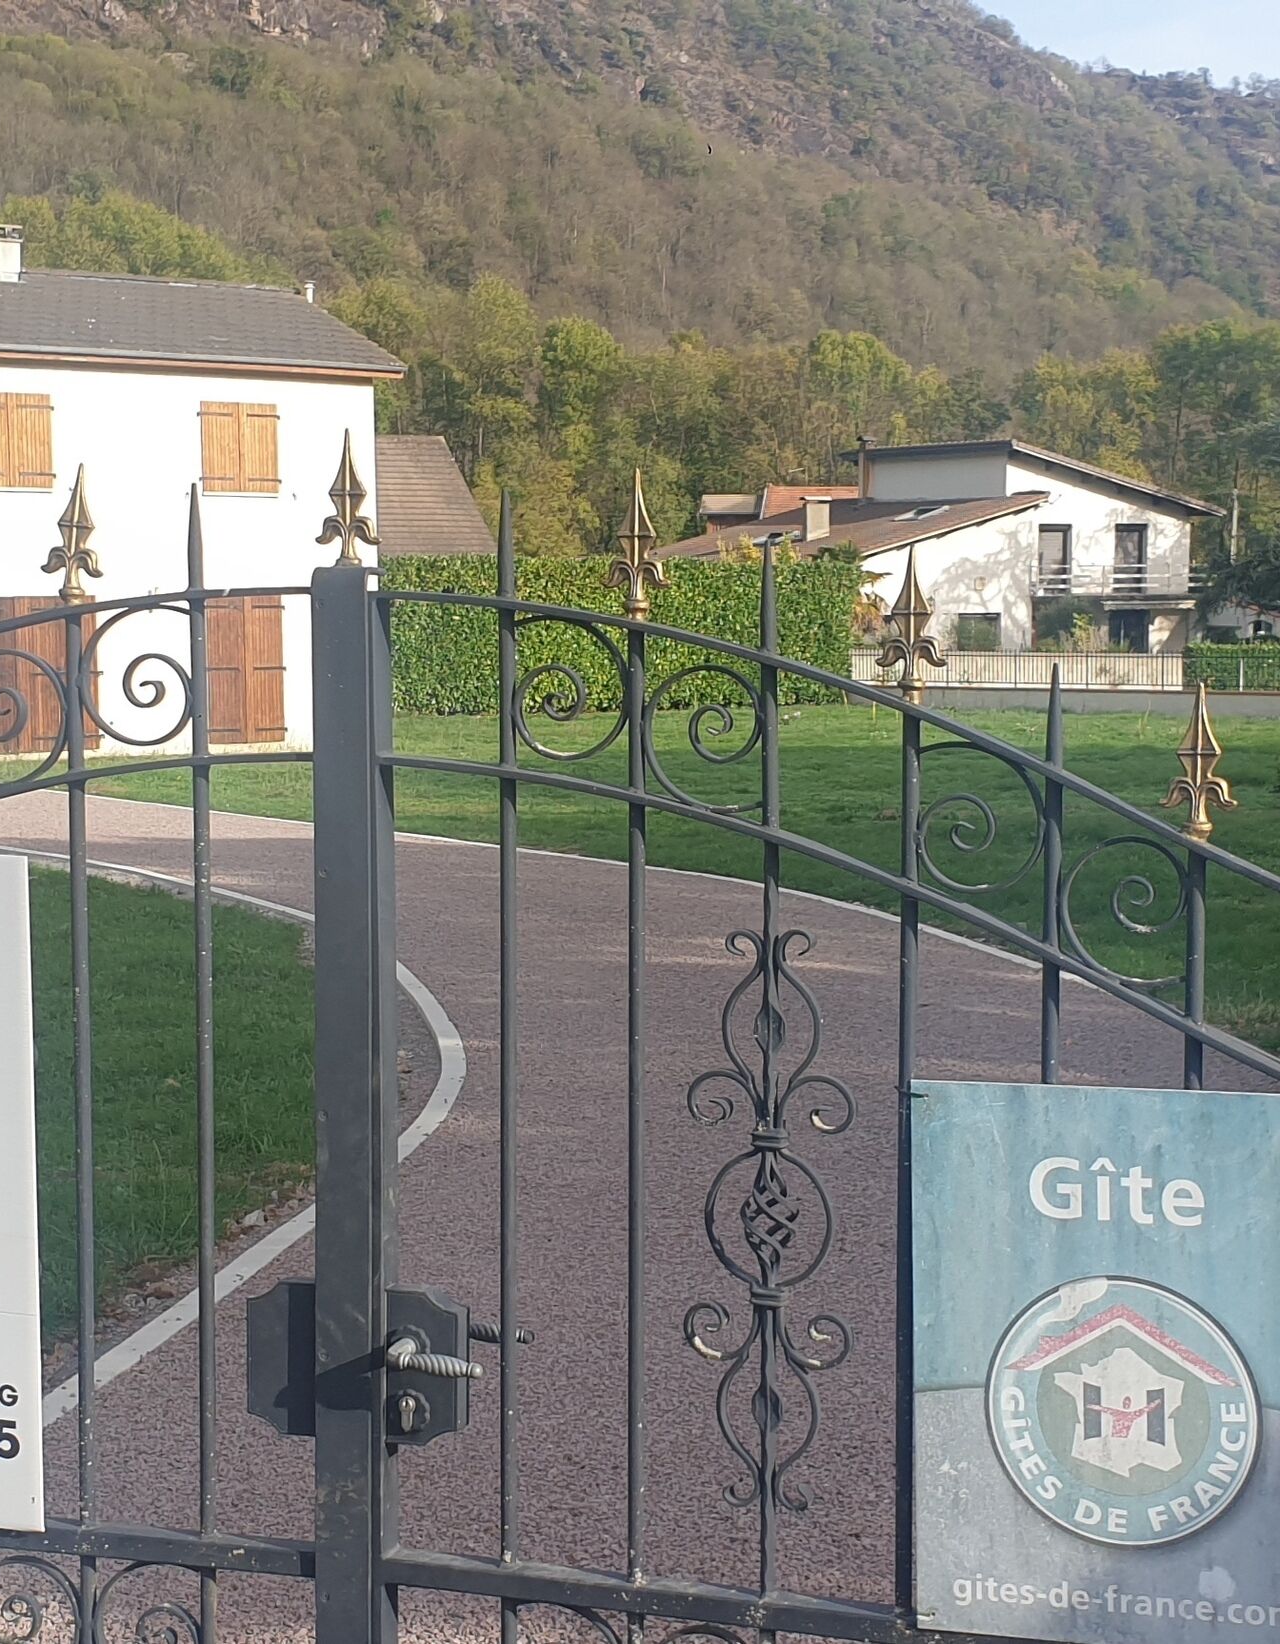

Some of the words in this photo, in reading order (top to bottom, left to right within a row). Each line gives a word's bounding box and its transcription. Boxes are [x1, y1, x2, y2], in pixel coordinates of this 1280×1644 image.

[1029, 1156, 1205, 1228] Gîte
[1000, 1386, 1064, 1500] GÎTES
[1073, 1502, 1128, 1534] DE
[1147, 1401, 1246, 1533] FRANCE
